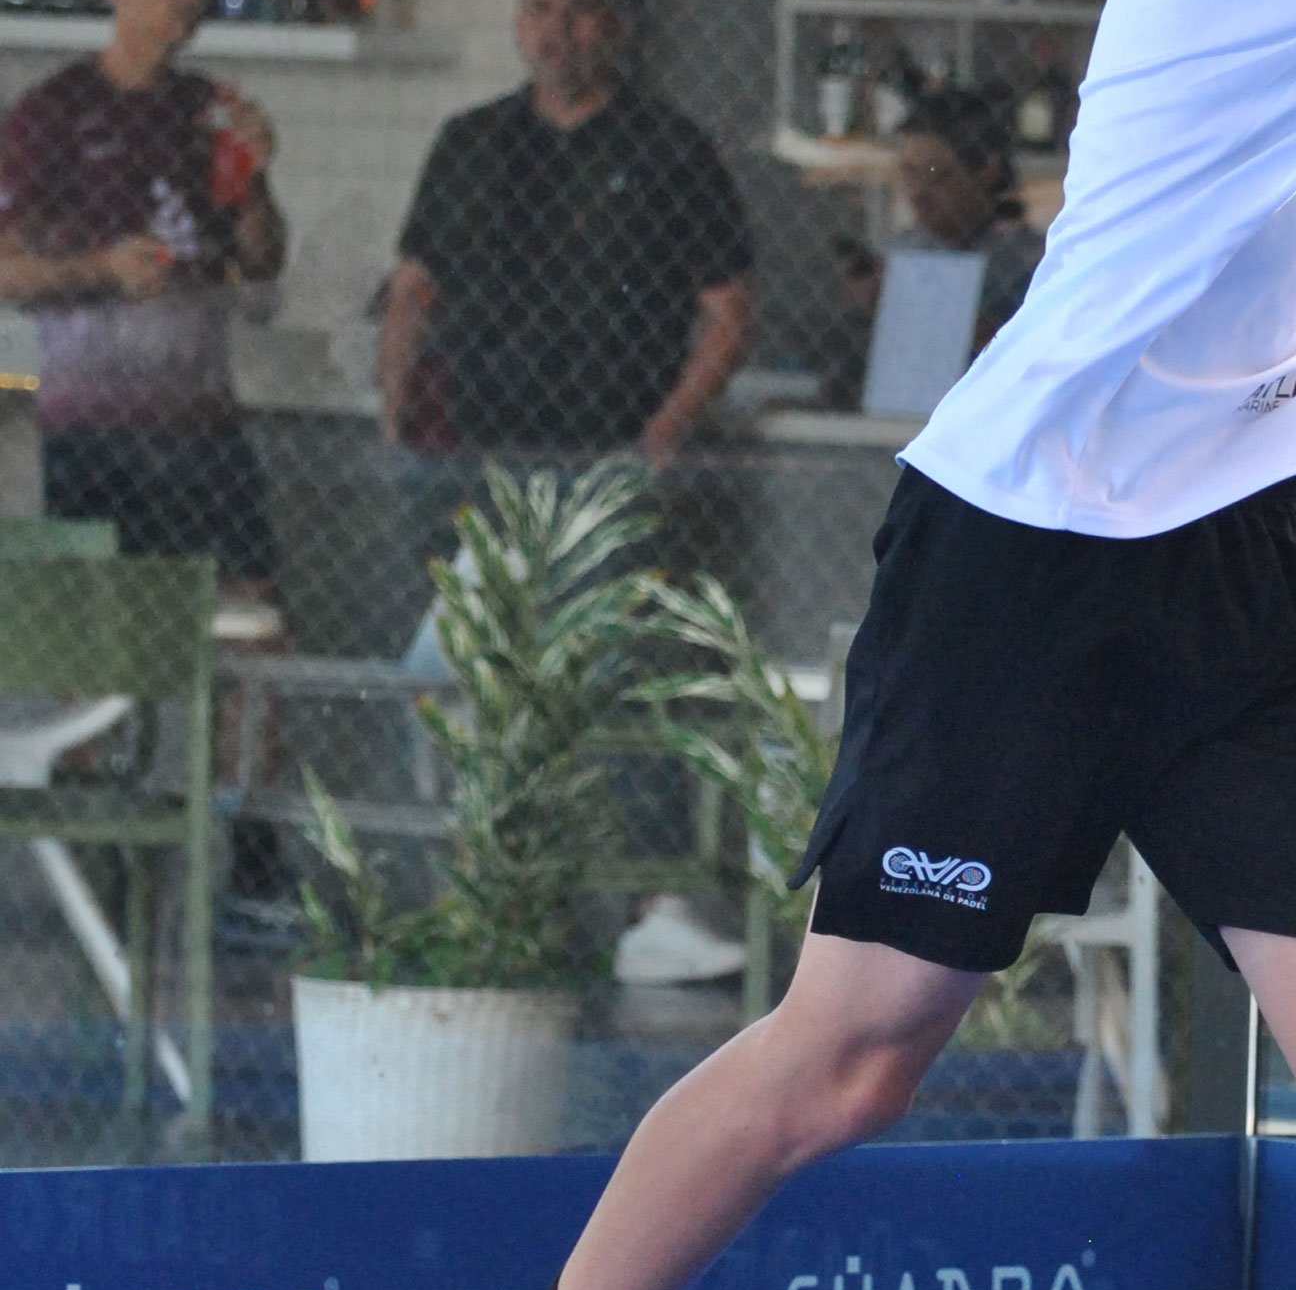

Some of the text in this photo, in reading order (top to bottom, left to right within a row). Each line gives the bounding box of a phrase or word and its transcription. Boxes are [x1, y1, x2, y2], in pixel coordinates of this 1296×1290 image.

[880, 884, 987, 911] VENEZOLANA DE PADEL
